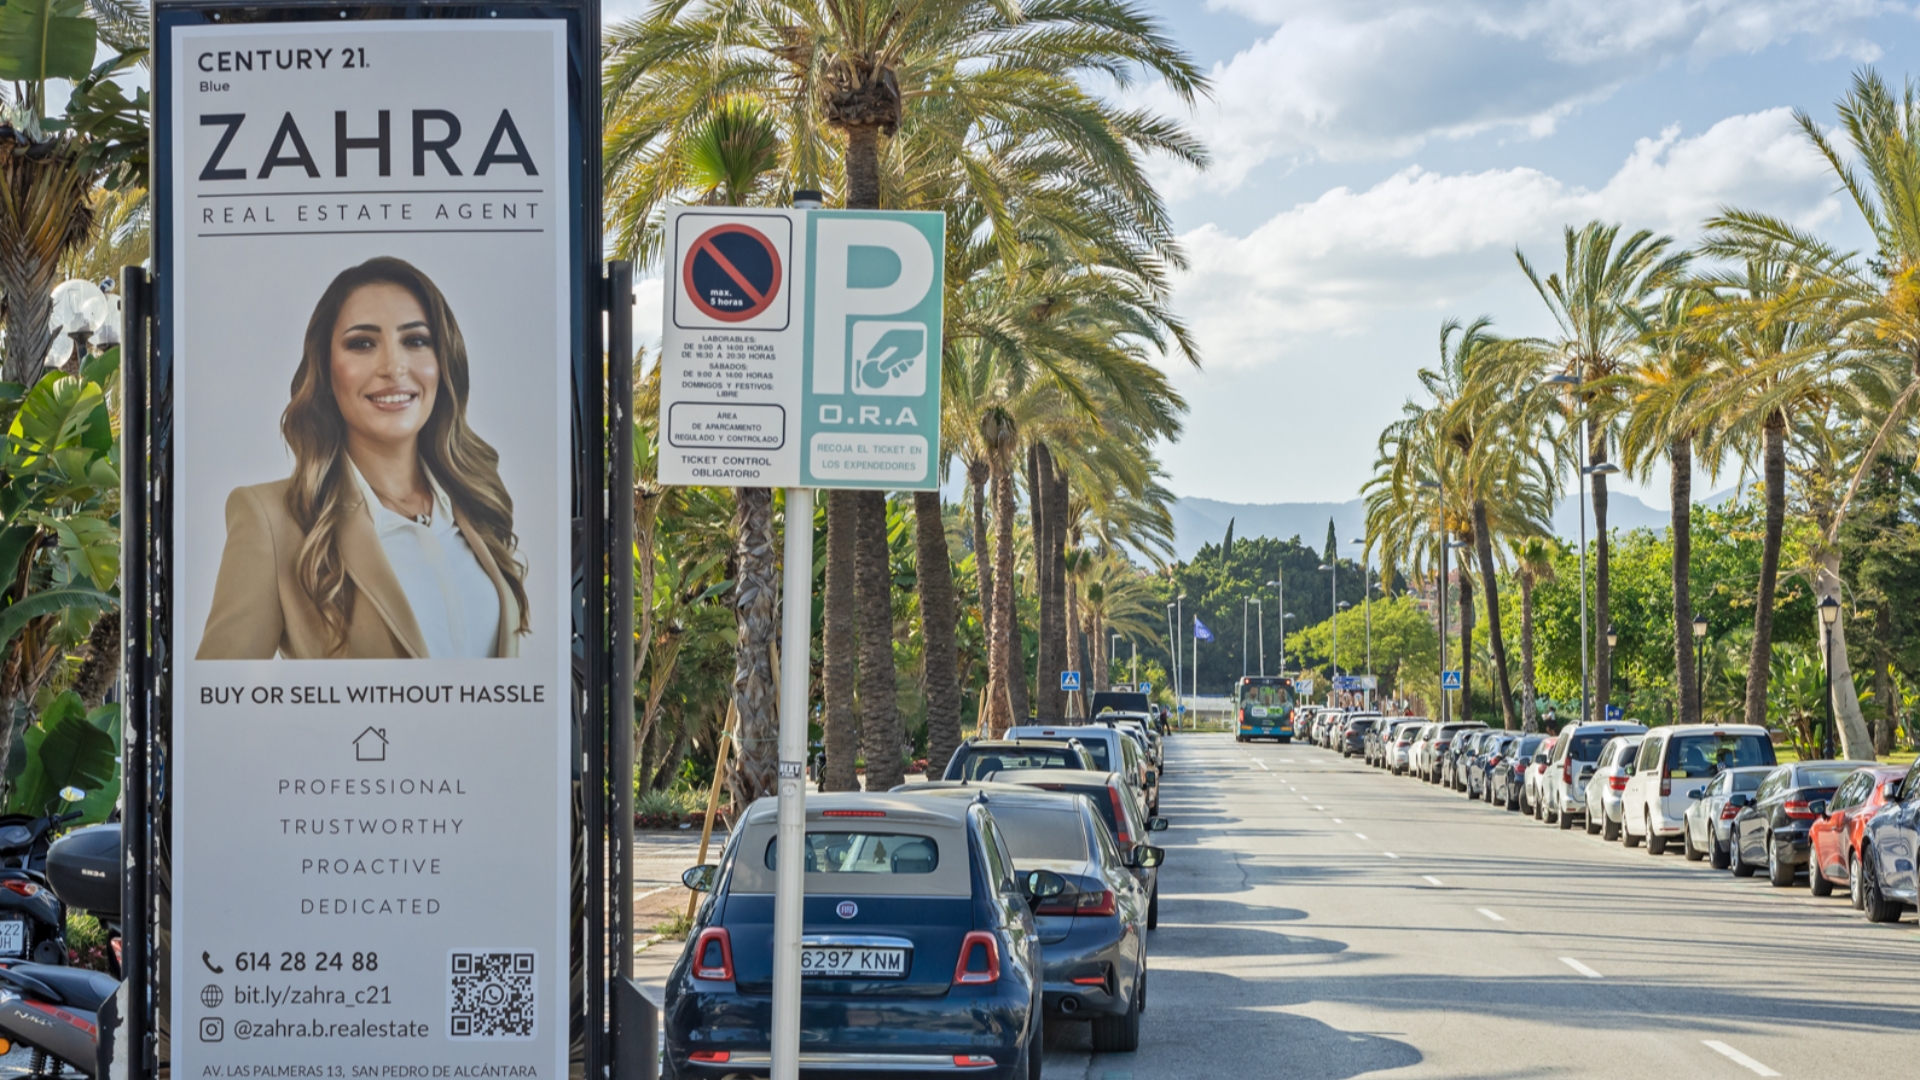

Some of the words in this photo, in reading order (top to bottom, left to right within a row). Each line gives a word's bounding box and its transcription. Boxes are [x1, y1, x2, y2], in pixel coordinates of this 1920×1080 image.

[198, 48, 332, 72] CENTURY
[200, 81, 230, 92] Blue
[199, 108, 539, 181] ZAHRA
[203, 207, 274, 223] REAL
[298, 204, 411, 221] ESTATE
[435, 203, 538, 219] AGENT
[710, 289, 732, 297] max.
[711, 298, 716, 306] 5
[718, 298, 744, 307] horas
[812, 219, 934, 395] P
[682, 351, 692, 359] DE
[749, 353, 777, 361] HORAS
[683, 370, 693, 378] DE
[746, 372, 774, 380] HORAS
[682, 381, 723, 390] DOMINGOS
[717, 412, 738, 420] ÁREA
[819, 405, 918, 426] O.R.A
[692, 423, 702, 431] DE
[706, 423, 762, 432] APARCAMIENTO
[675, 434, 716, 442] REGULADO
[727, 435, 779, 444] CONTROLADO
[817, 443, 854, 454] RECOJA
[857, 445, 869, 454] EL
[873, 445, 906, 455] TICKET
[910, 446, 923, 455] EN
[682, 455, 718, 465] TICKET
[723, 457, 772, 467] CONTROL
[822, 460, 841, 470] LOS
[844, 460, 916, 471] EXPENDEDORES
[692, 468, 761, 479] OBLIGATORIO
[201, 687, 244, 704] BUY
[251, 687, 283, 704] OR
[291, 686, 340, 704] SELL
[347, 686, 453, 703] WITHOUT
[460, 685, 544, 703] HASSLE
[279, 779, 465, 795] PROFESSIONAL
[280, 819, 463, 834] TRUSTWORTHY
[302, 859, 440, 874] PROACTIVE
[301, 899, 440, 914] DEDICATED
[0, 923, 20, 936] 22
[236, 952, 271, 971] 614
[280, 952, 306, 971] 28
[315, 952, 343, 971] 24
[352, 952, 378, 971] 88
[801, 951, 853, 968] 6297
[861, 952, 900, 970] KNM
[235, 985, 391, 1008] bit.ly/zahra_c21
[234, 1018, 429, 1040] @zahra.b.realestate
[203, 1065, 223, 1077] AV.
[227, 1065, 250, 1077] LAS
[253, 1065, 323, 1077] PALMERAS
[327, 1065, 345, 1078] 13,
[352, 1065, 378, 1077] SAN
[383, 1065, 429, 1077] PEDRO
[433, 1065, 450, 1077] DE
[454, 1063, 537, 1077] ALCÁNTARA
